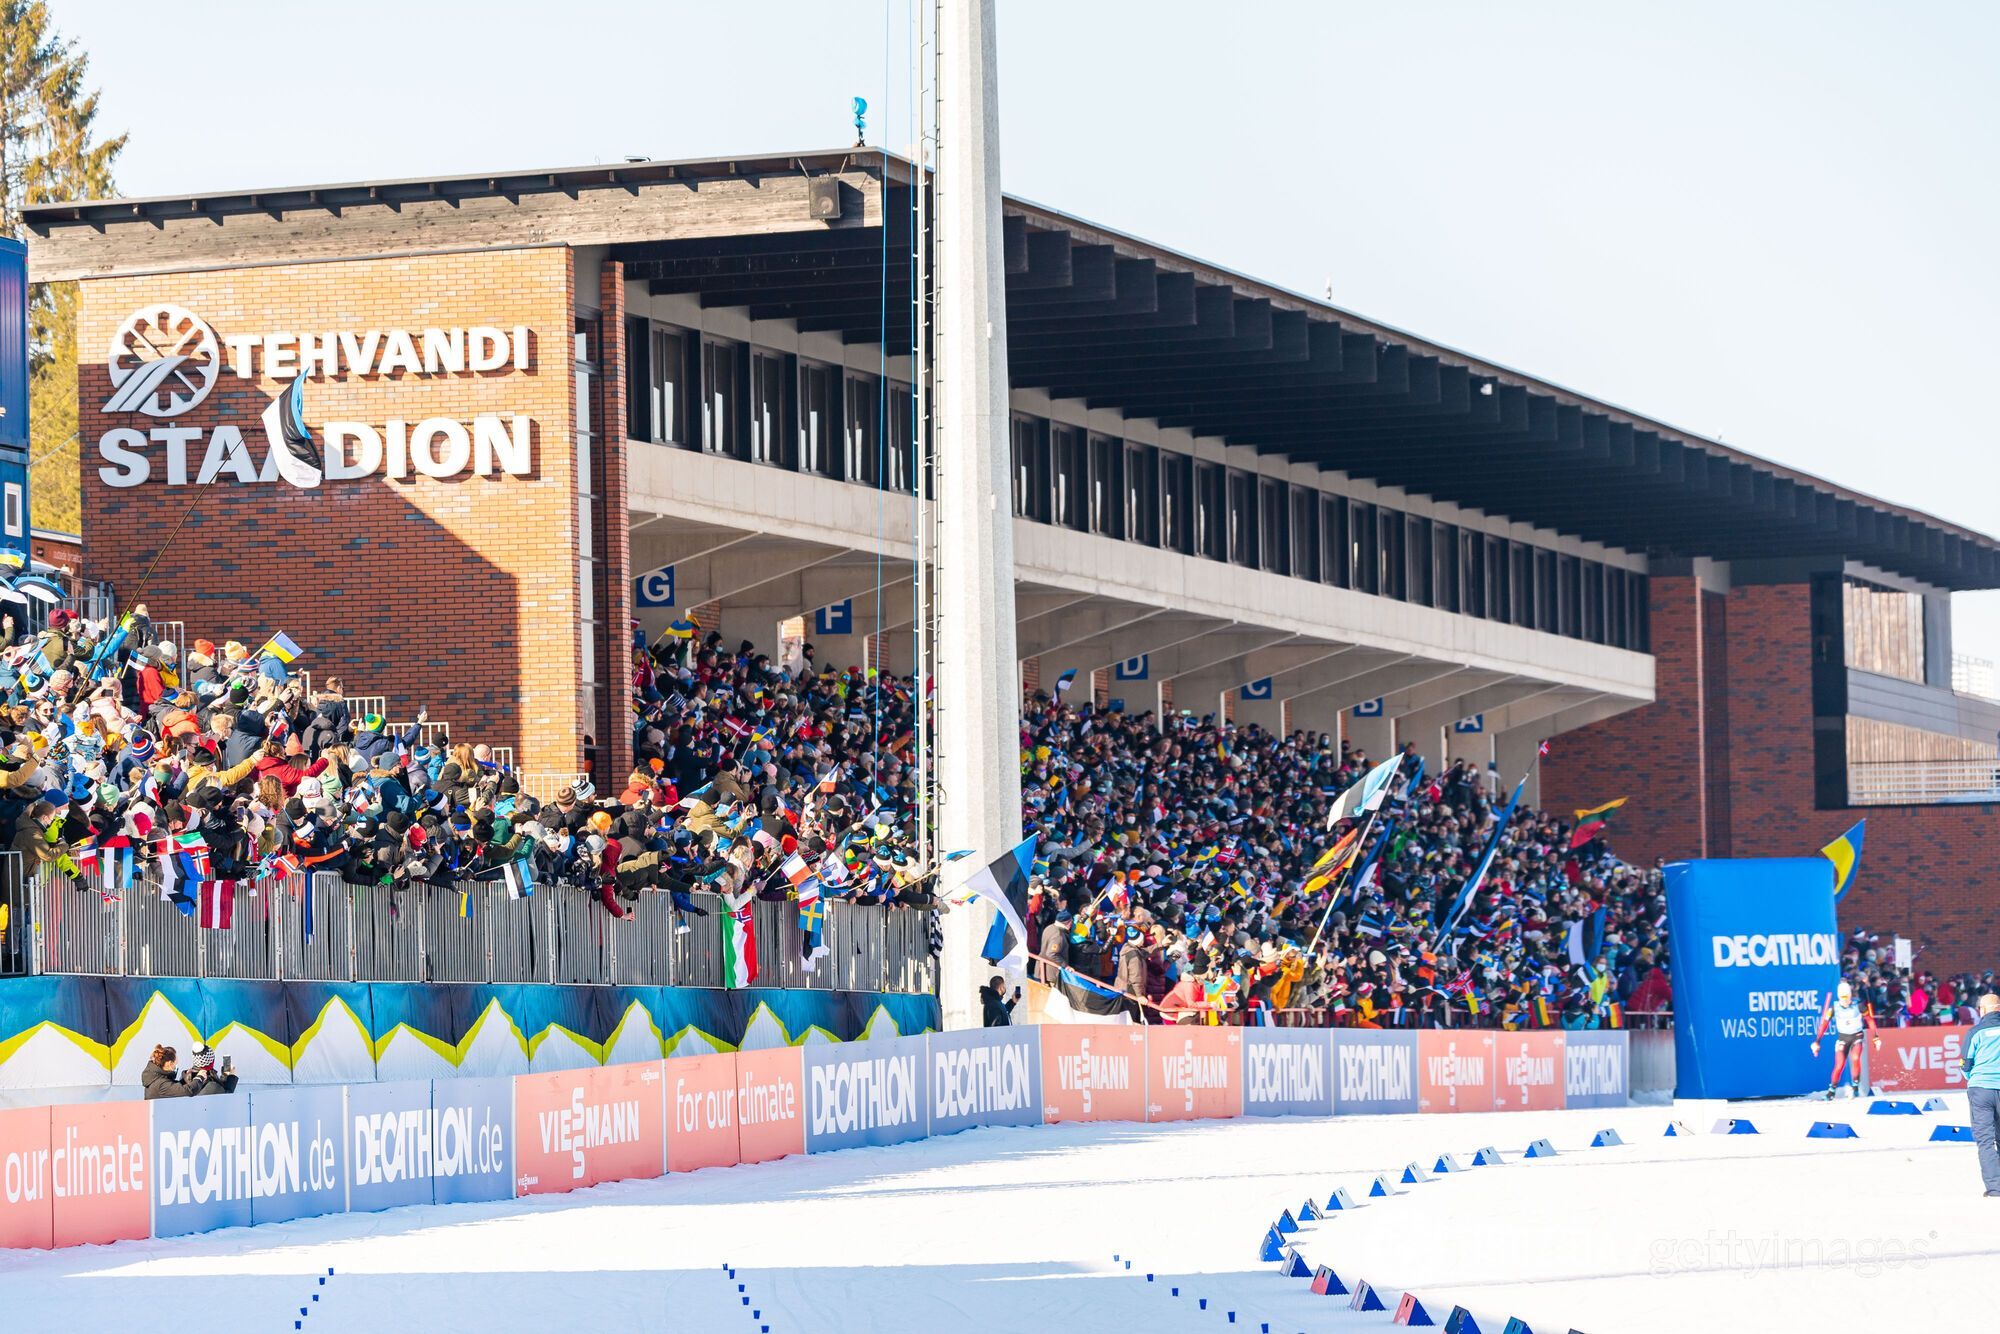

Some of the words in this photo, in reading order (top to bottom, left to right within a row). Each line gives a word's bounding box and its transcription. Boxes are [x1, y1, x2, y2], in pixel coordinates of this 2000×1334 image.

[225, 325, 533, 379] TEHVANDI
[642, 571, 670, 602] G
[825, 600, 845, 630] F
[1122, 655, 1143, 676] D
[1459, 715, 1481, 729] A
[1712, 933, 1840, 968] DECATHLON
[1721, 1018, 1757, 1038] WAS
[1761, 1017, 1794, 1037] DICH
[1749, 990, 1821, 1013] ENTDECKE,
[810, 1055, 916, 1136] DECATHLON
[936, 1043, 1031, 1118] DECATHLON
[1058, 1038, 1129, 1113] VIESSMANN
[1162, 1040, 1227, 1112] VIESSMANN
[1248, 1043, 1324, 1103] DECATHLON
[1338, 1043, 1411, 1102] DECATHLON
[1428, 1042, 1485, 1106] VIESSMANN
[1505, 1043, 1555, 1105] VIESSMANN
[1566, 1044, 1622, 1096] DECATHLON
[677, 1077, 702, 1133] for
[706, 1089, 735, 1130] our
[738, 1071, 795, 1125] climate
[538, 1086, 640, 1180] VIESSMANN
[5, 1148, 49, 1204] our
[53, 1126, 144, 1198] climate
